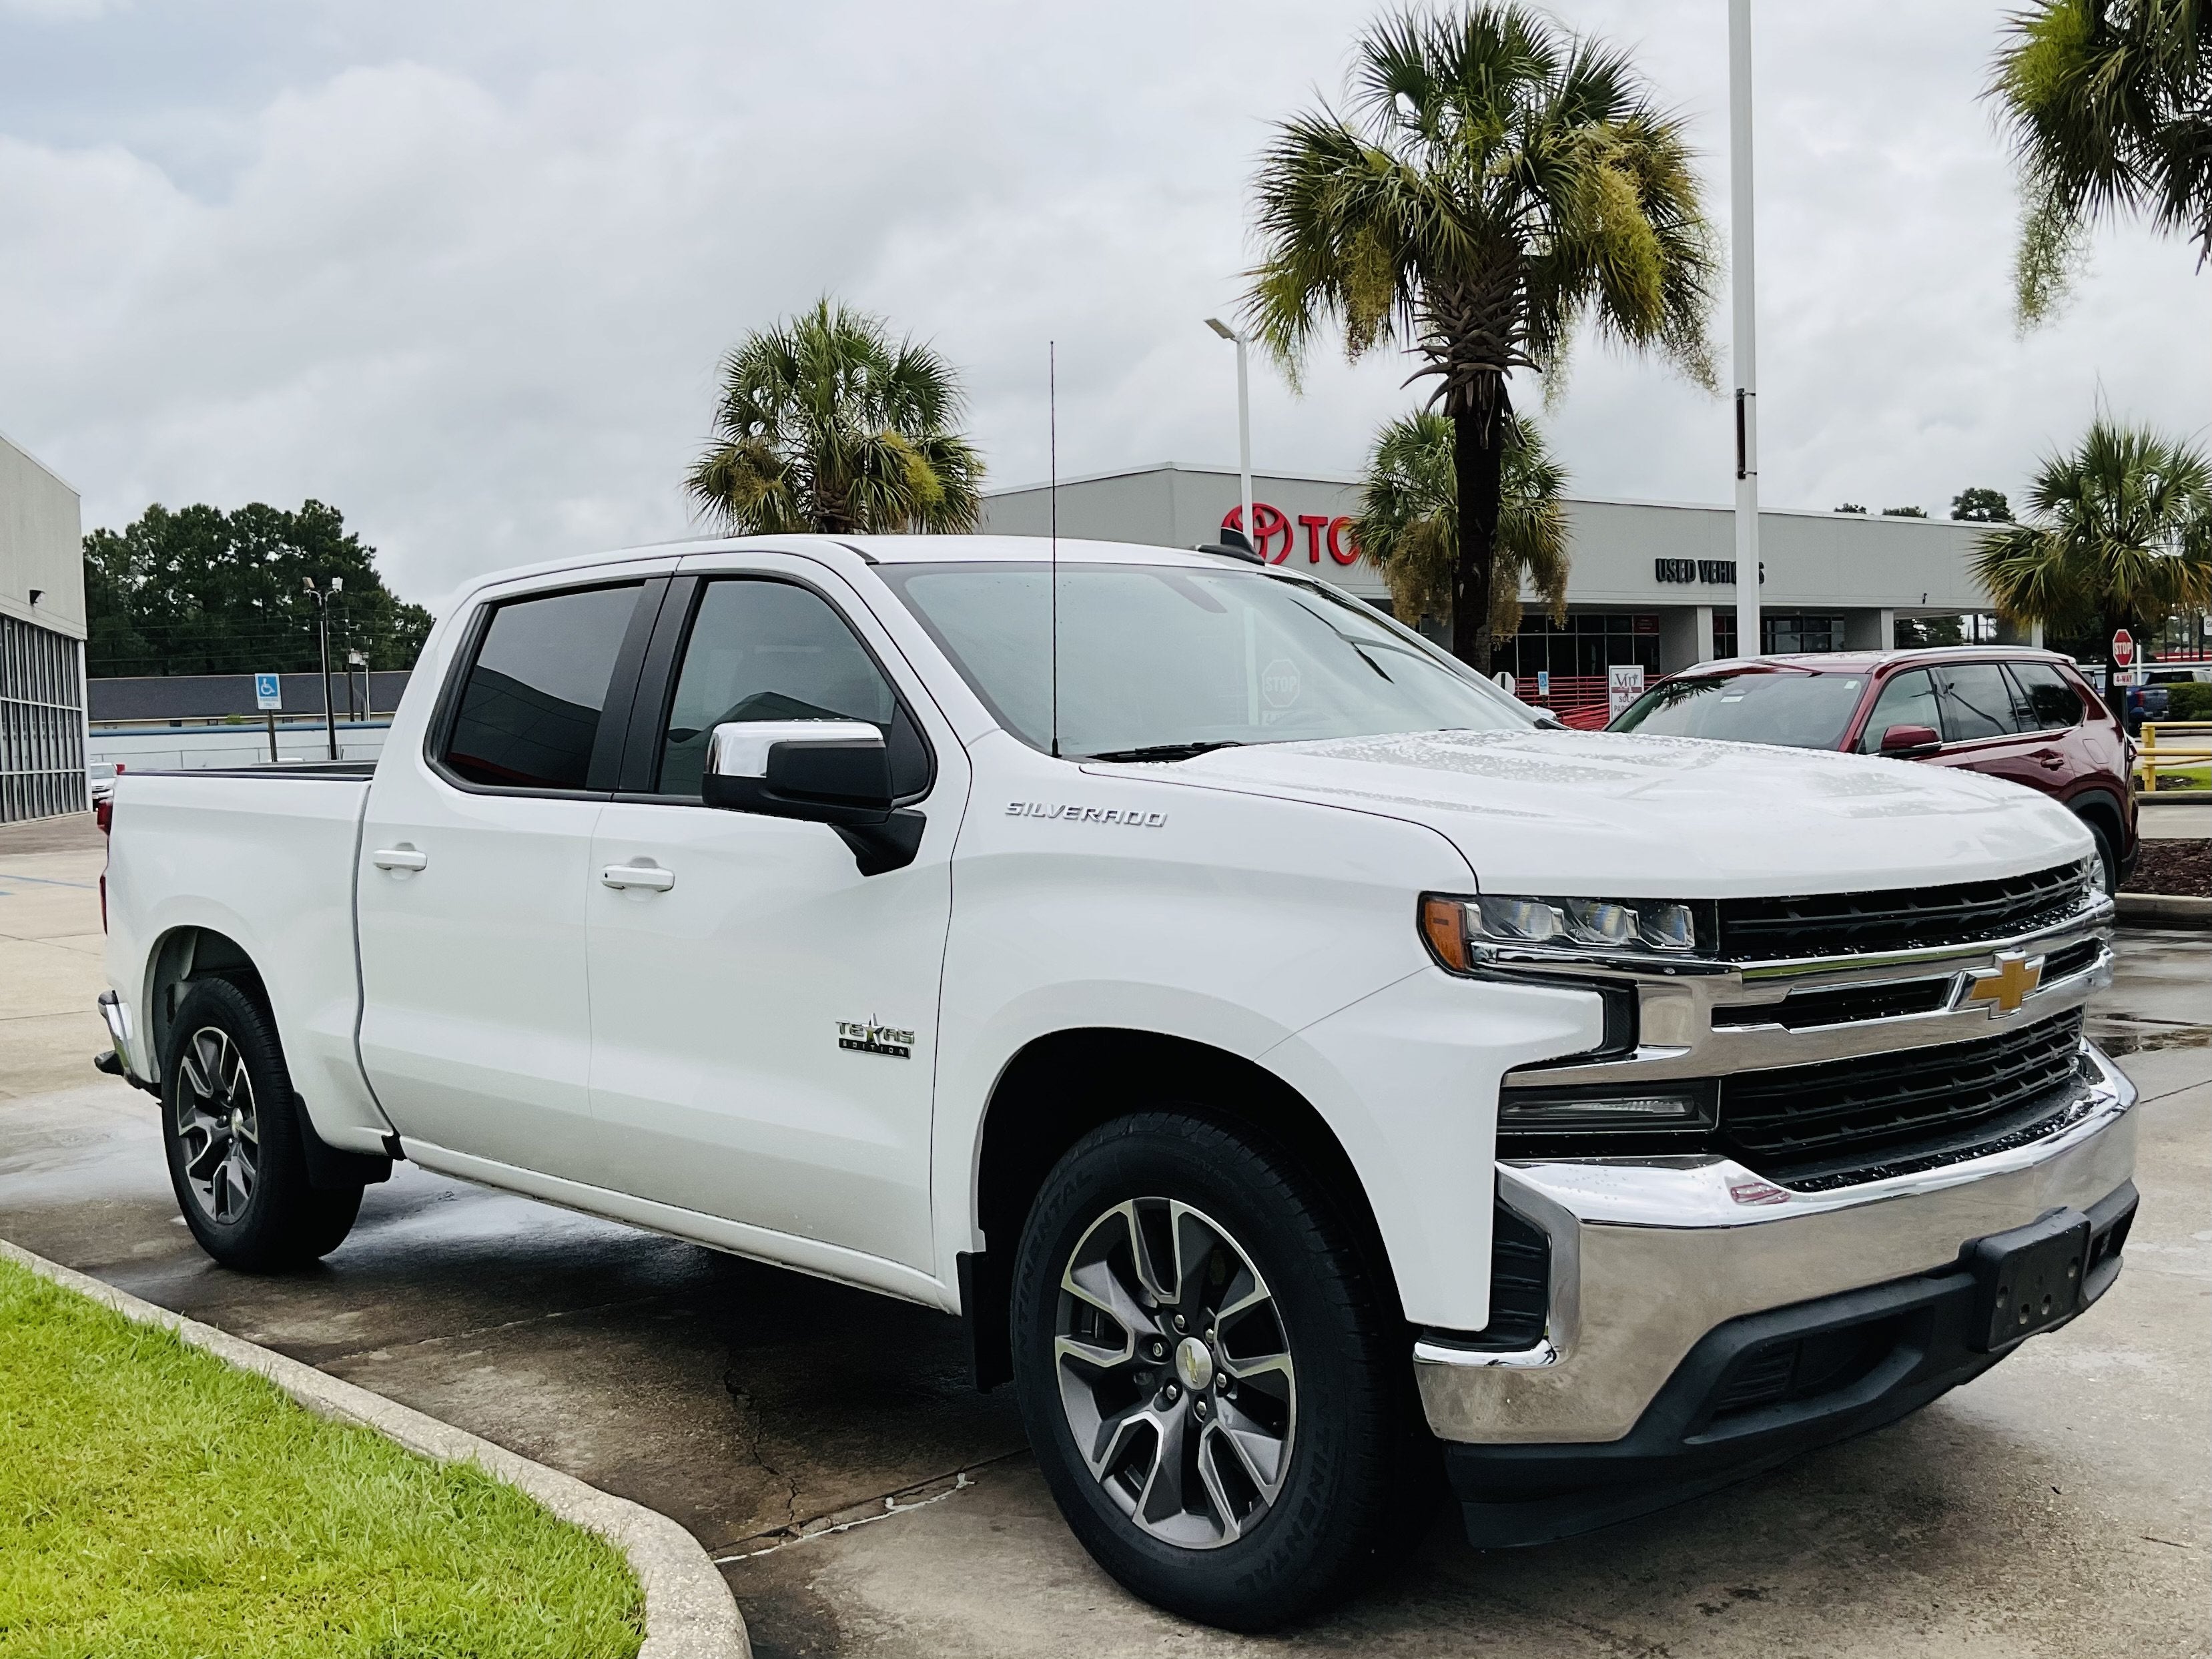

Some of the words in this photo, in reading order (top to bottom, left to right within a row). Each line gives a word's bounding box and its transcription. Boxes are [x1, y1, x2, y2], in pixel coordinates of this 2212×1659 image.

[1299, 515, 1380, 566] TO
[1655, 558, 1696, 583] USED
[1698, 559, 1765, 585] VEHIS
[2114, 642, 2131, 655] STOP
[1265, 675, 1297, 692] STOP
[2116, 675, 2133, 683] 4-WAY
[1005, 801, 1168, 828] SILVERADO
[842, 1040, 905, 1054] EDITION
